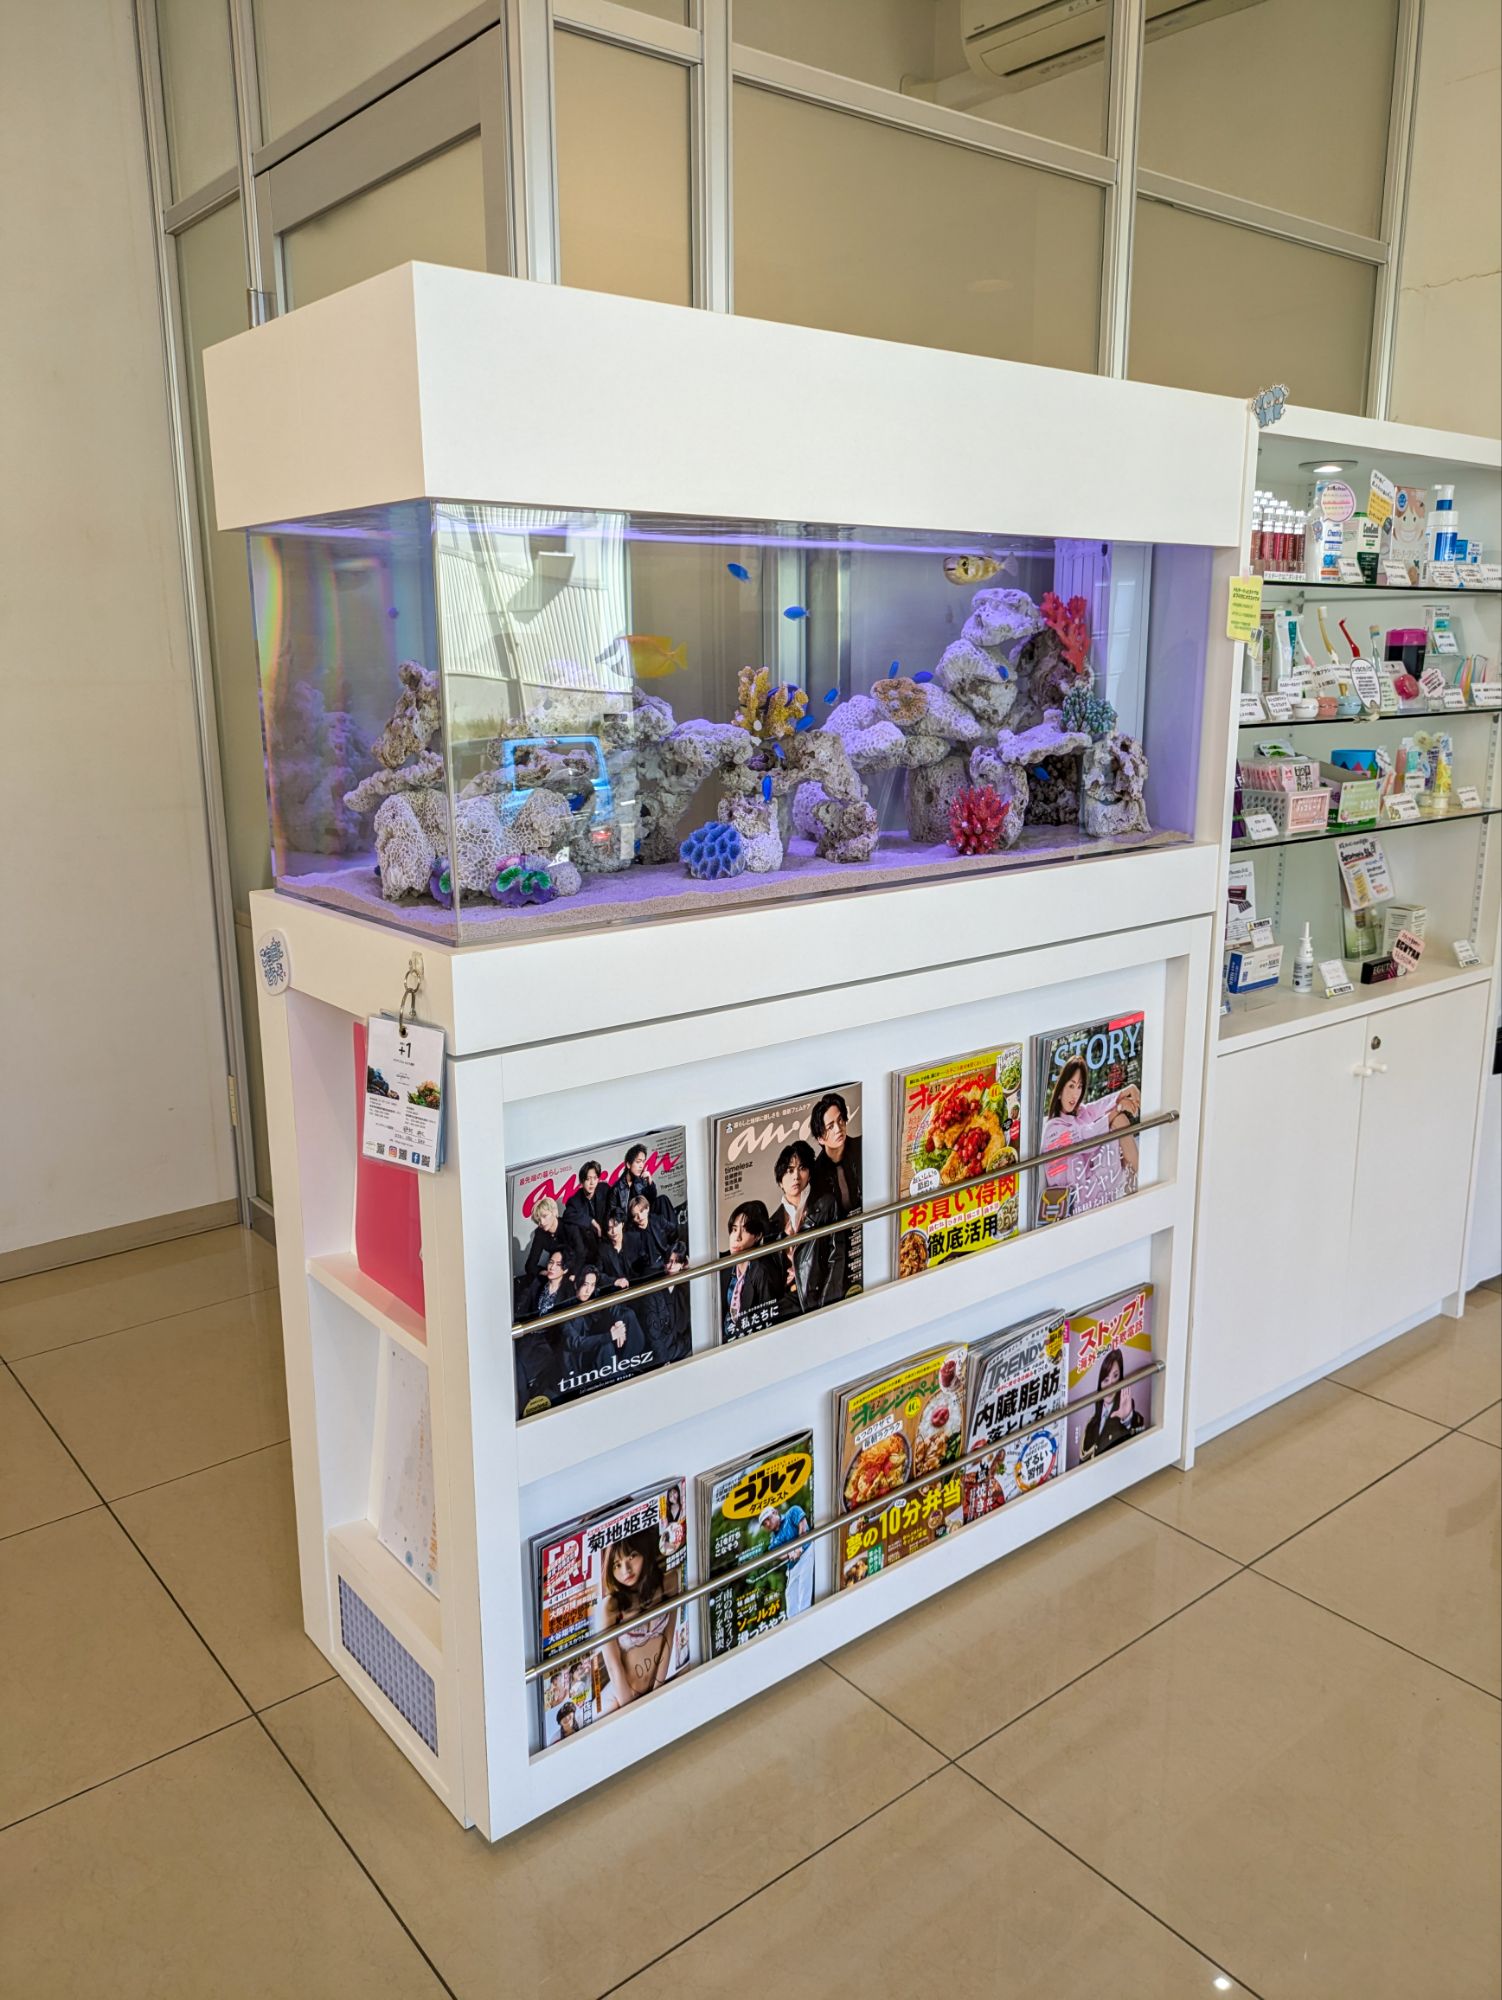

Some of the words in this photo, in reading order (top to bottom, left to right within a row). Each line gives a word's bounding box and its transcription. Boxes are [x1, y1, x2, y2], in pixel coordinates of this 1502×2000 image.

[927, 1213, 998, 1258] 徹底活用
[557, 1351, 654, 1392] timelesz
[972, 1367, 1061, 1437] 内臓脂肪
[734, 1458, 806, 1512] ゴルフ
[749, 1491, 789, 1514] ダイジェスト
[588, 1504, 658, 1553] 菊地姫奈
[846, 1478, 961, 1560] 夢の10分弁当
[737, 1600, 780, 1632] ソールが
